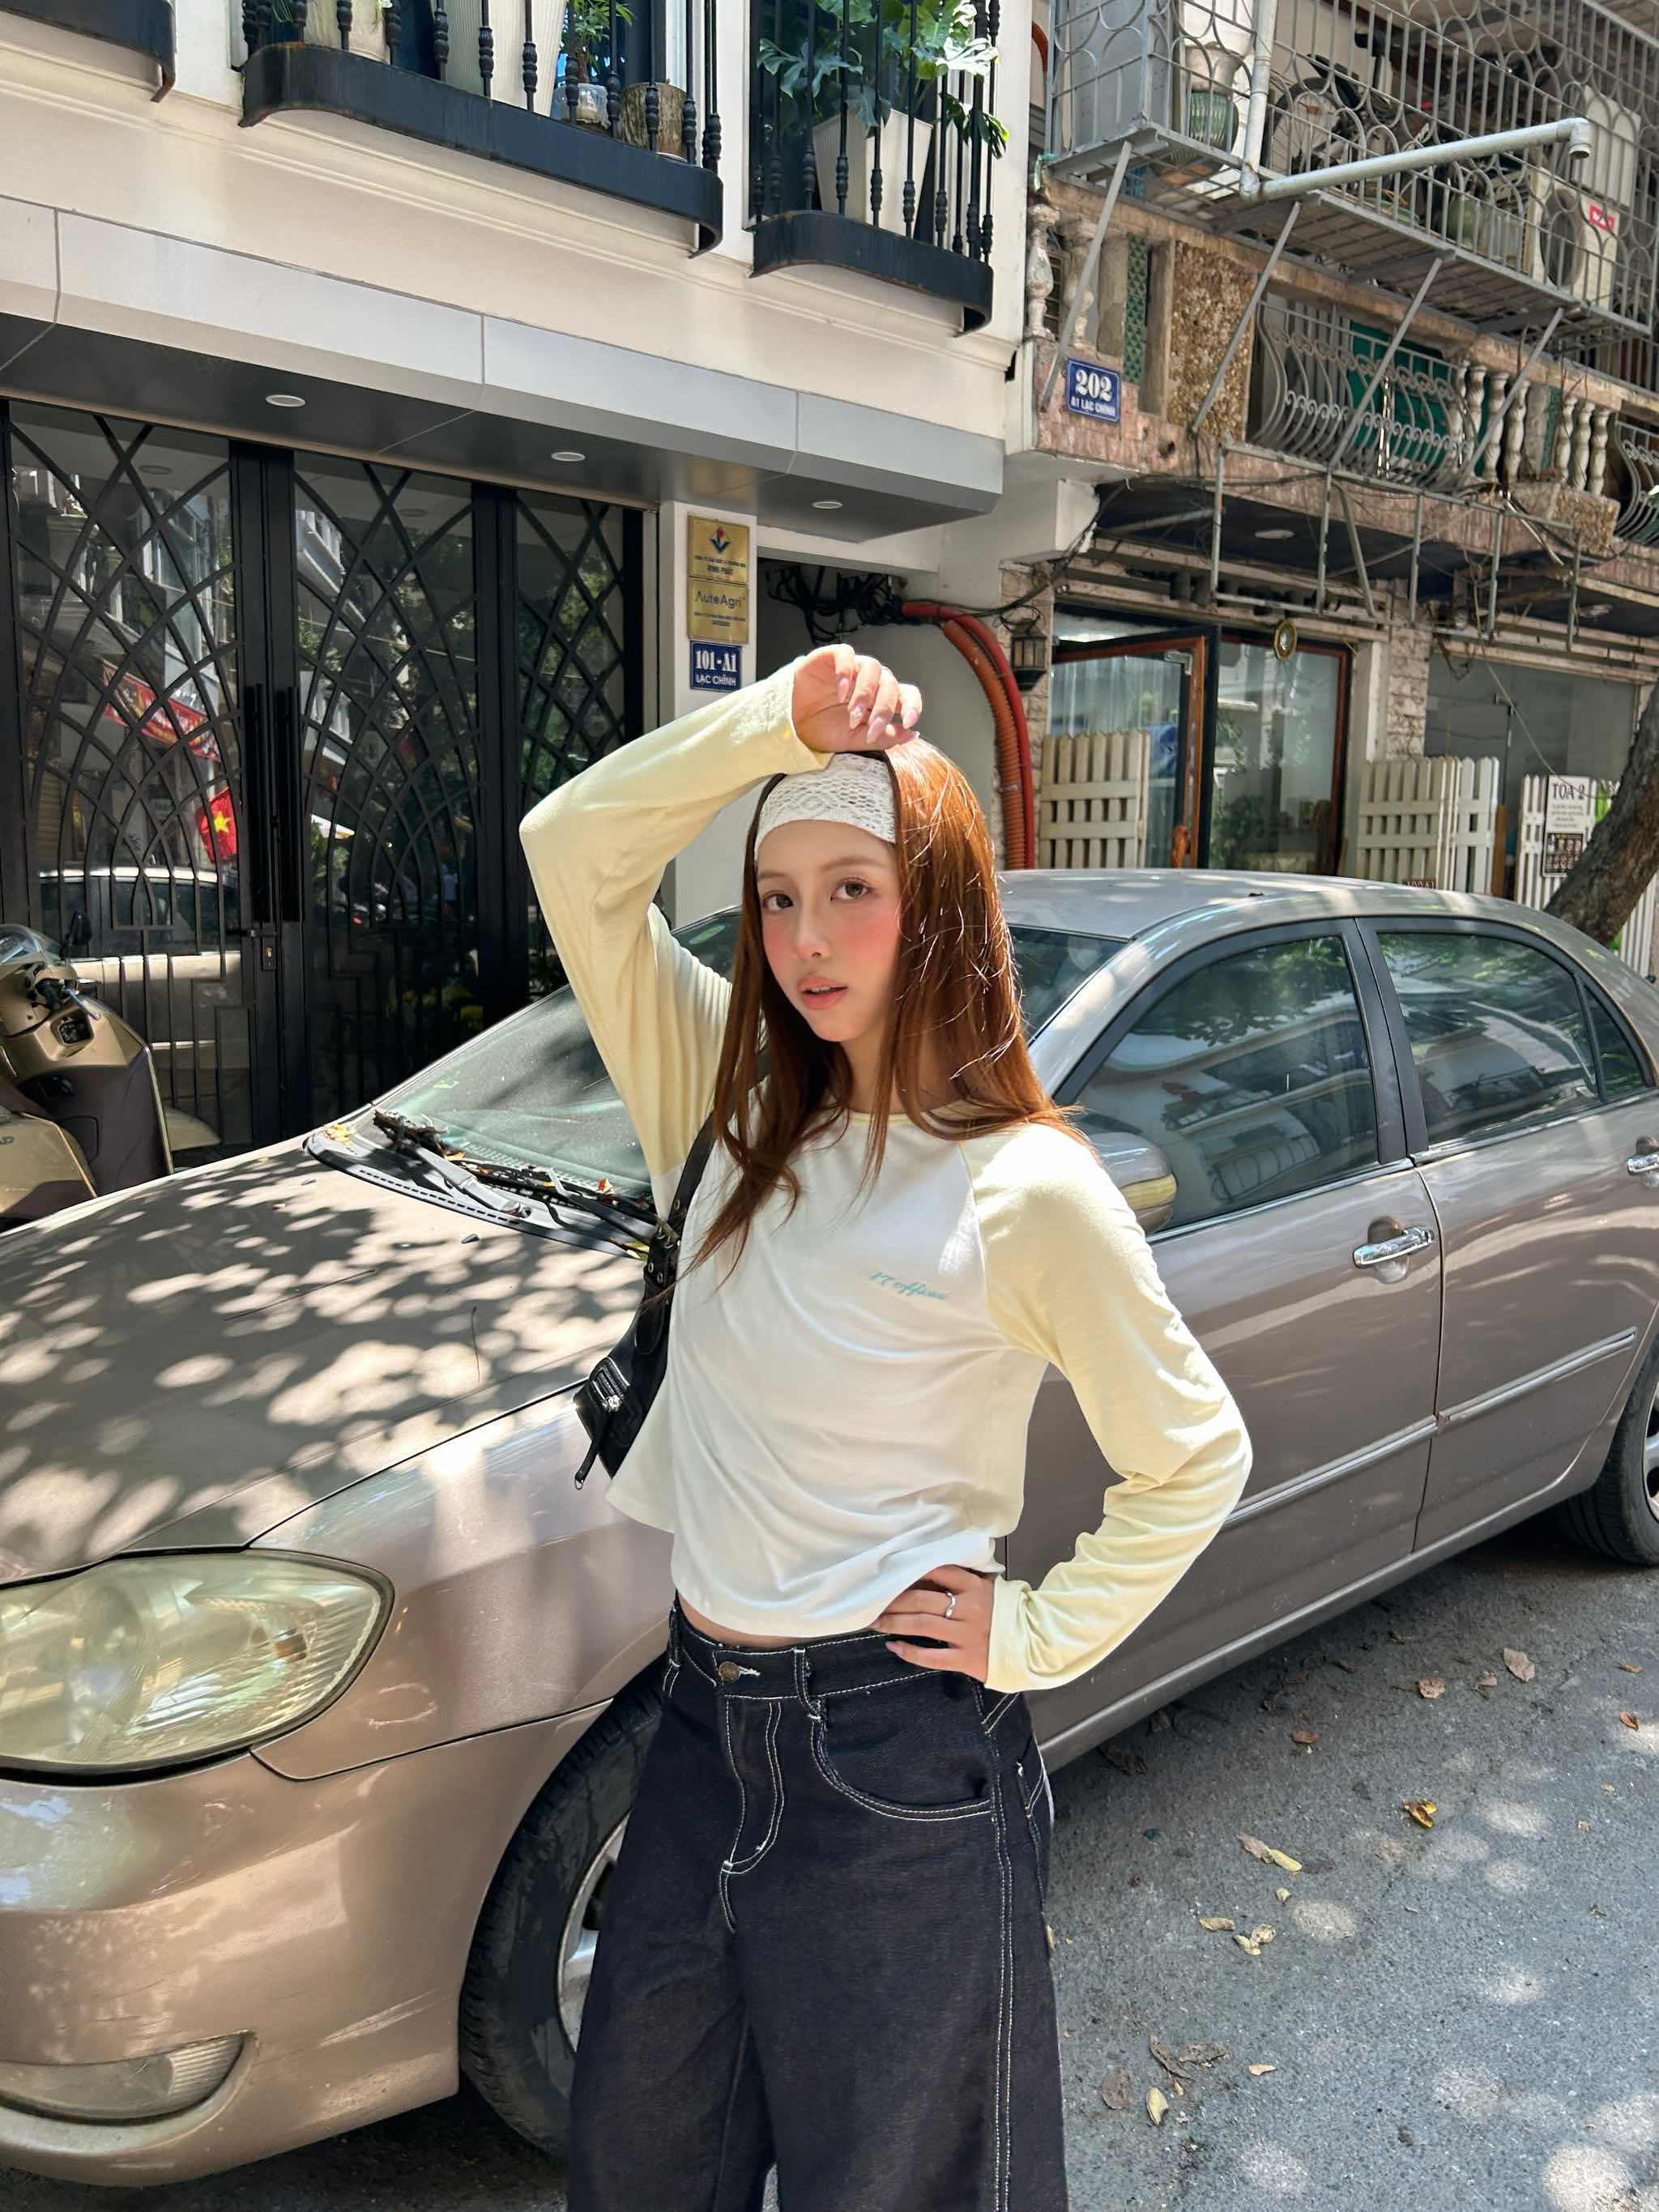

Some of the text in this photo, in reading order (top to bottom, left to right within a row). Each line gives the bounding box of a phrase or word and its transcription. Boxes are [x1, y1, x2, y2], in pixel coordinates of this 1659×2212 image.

[1075, 369, 1113, 403] 202
[695, 673, 736, 686] LẠC CHÍNH
